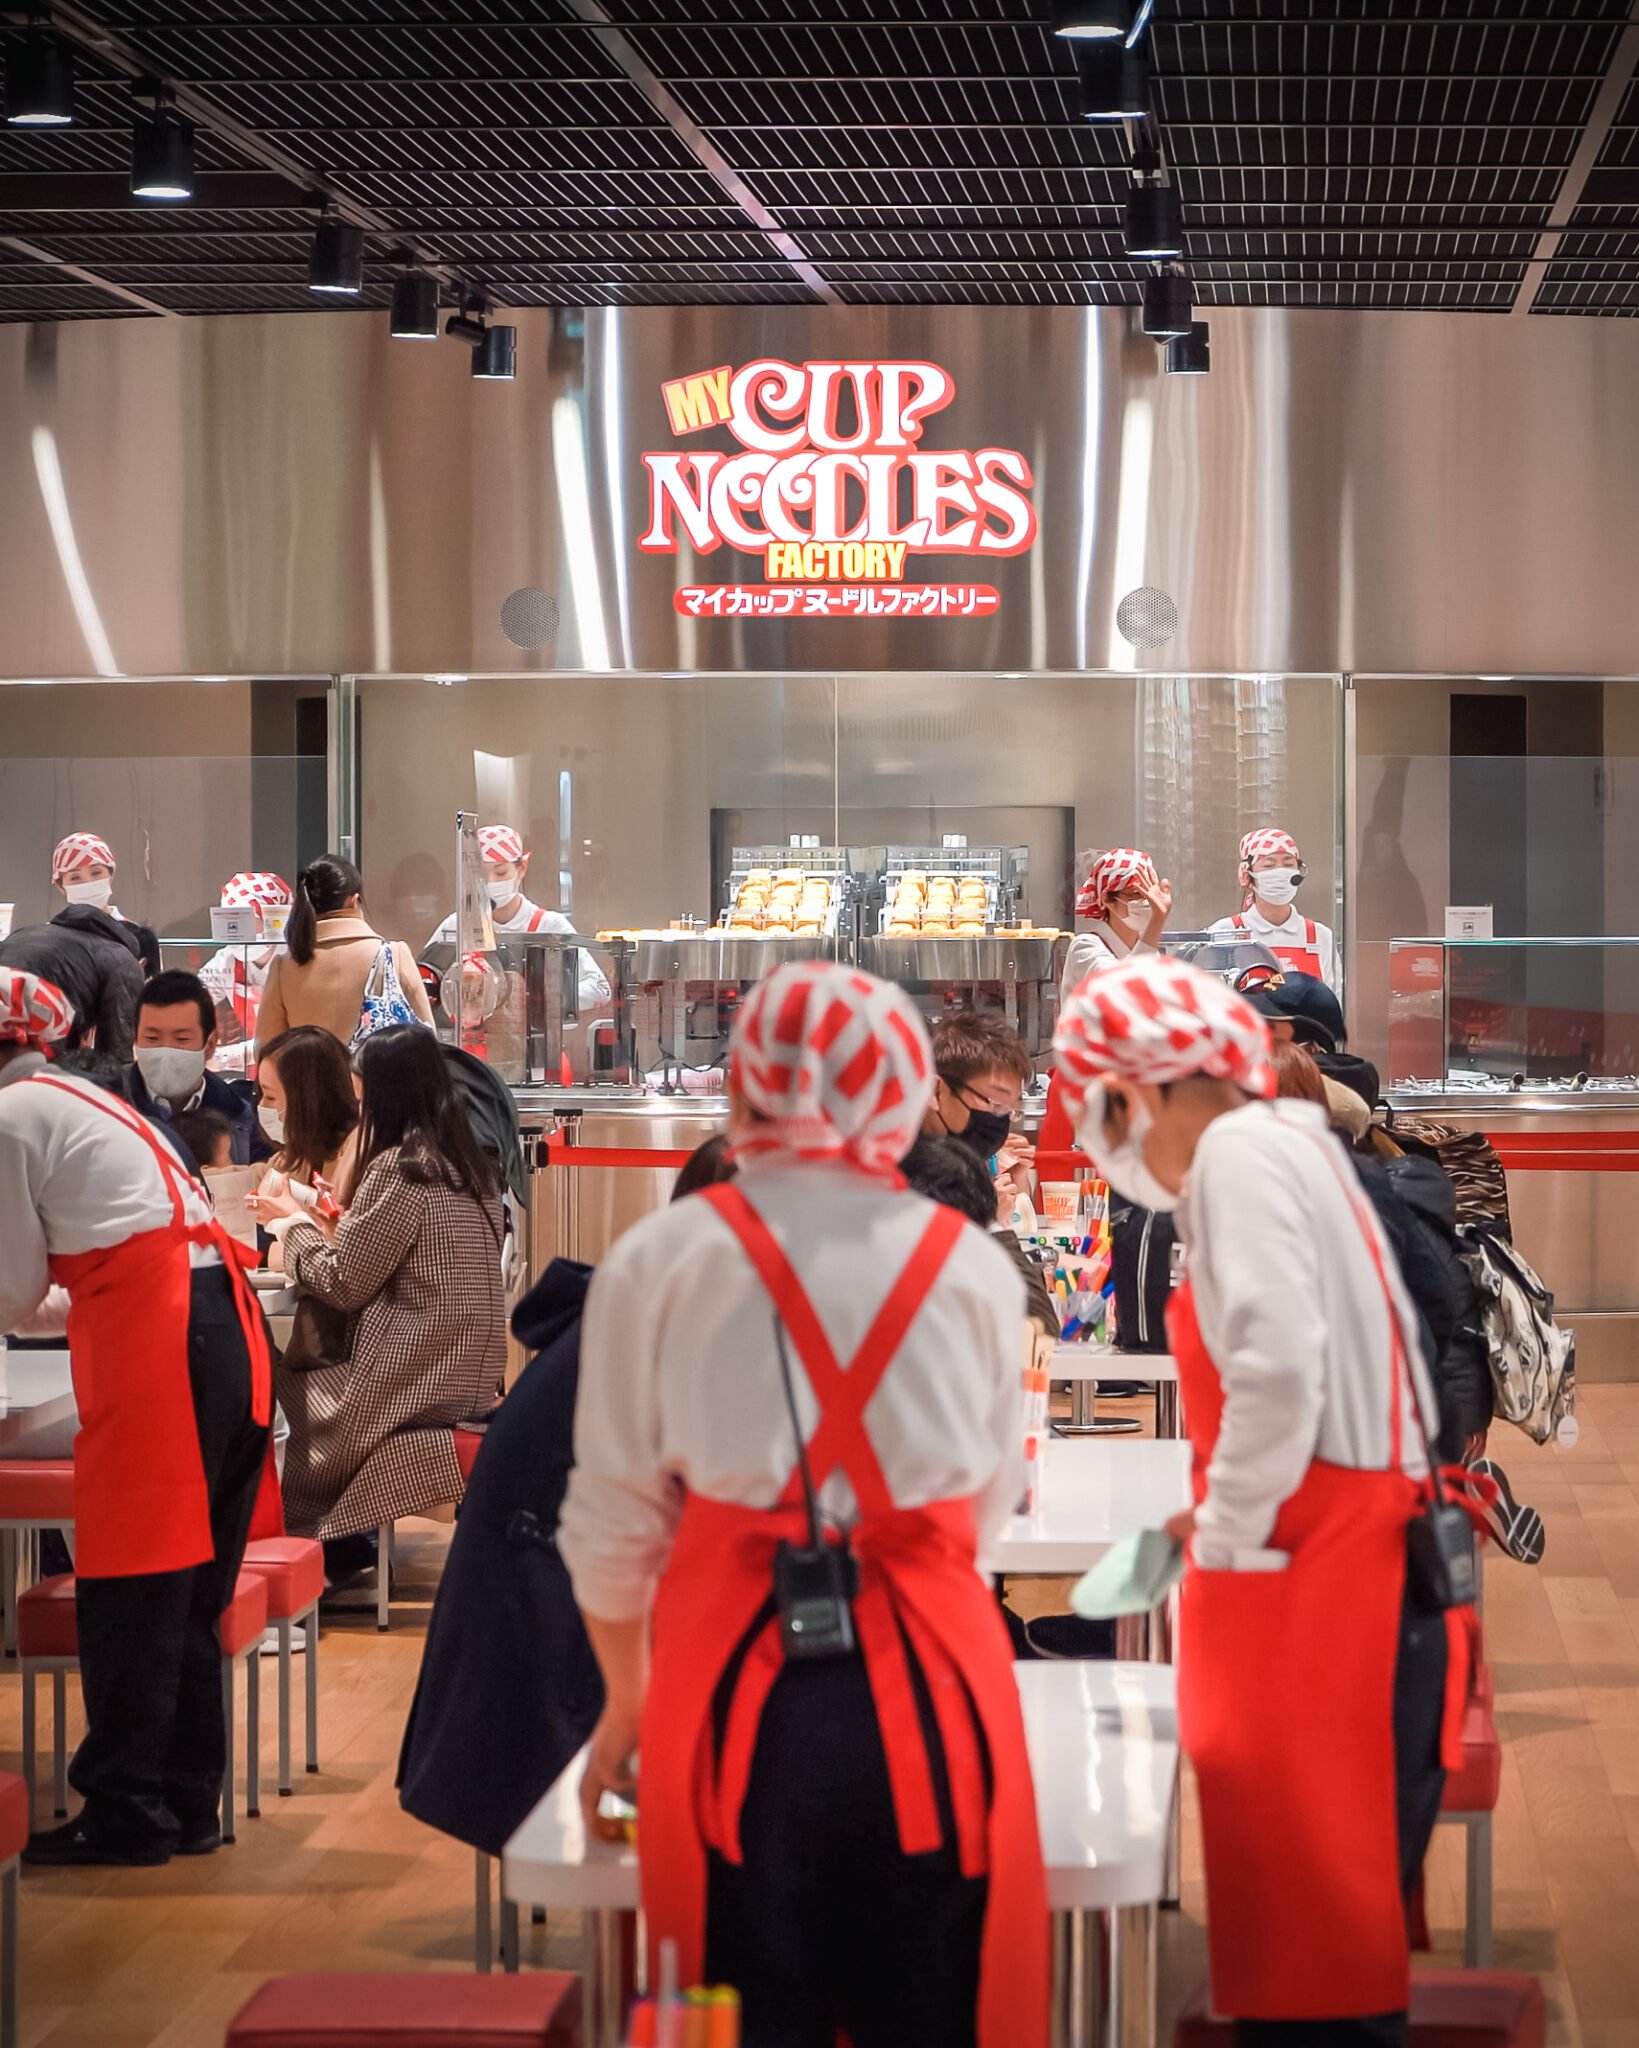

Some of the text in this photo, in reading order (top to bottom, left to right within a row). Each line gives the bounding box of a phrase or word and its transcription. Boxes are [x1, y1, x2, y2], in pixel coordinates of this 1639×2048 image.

[663, 360, 953, 453] MY CUP
[638, 448, 1036, 555] NOODLES
[766, 541, 907, 580] FACTORY
[681, 587, 998, 616] マイカップヌードルファクトリー
